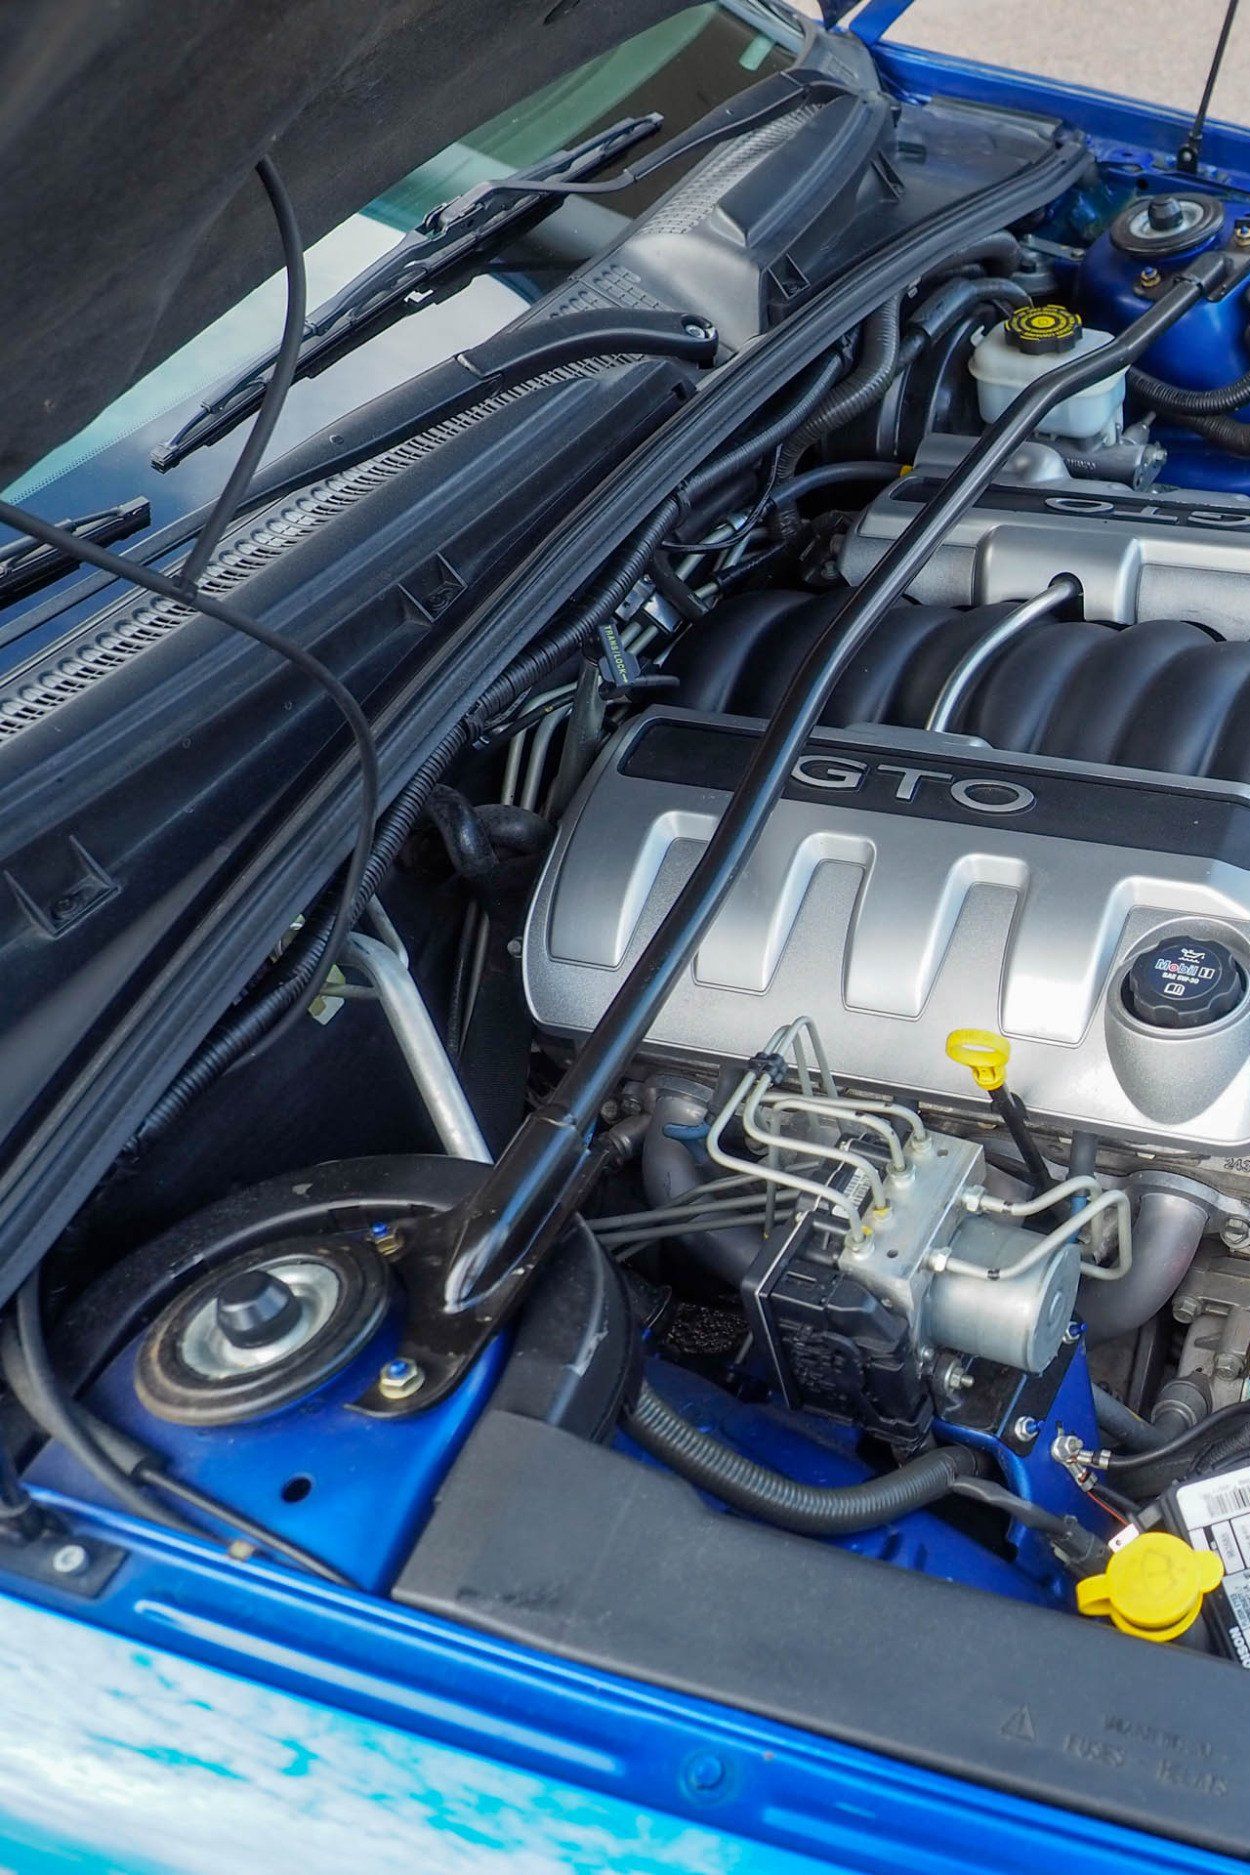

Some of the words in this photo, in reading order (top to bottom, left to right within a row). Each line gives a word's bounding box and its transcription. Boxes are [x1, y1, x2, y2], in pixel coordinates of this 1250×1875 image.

[603, 625, 627, 675] TRANS/LOCK
[790, 754, 1036, 814] GTO
[1154, 958, 1201, 977] Mobil
